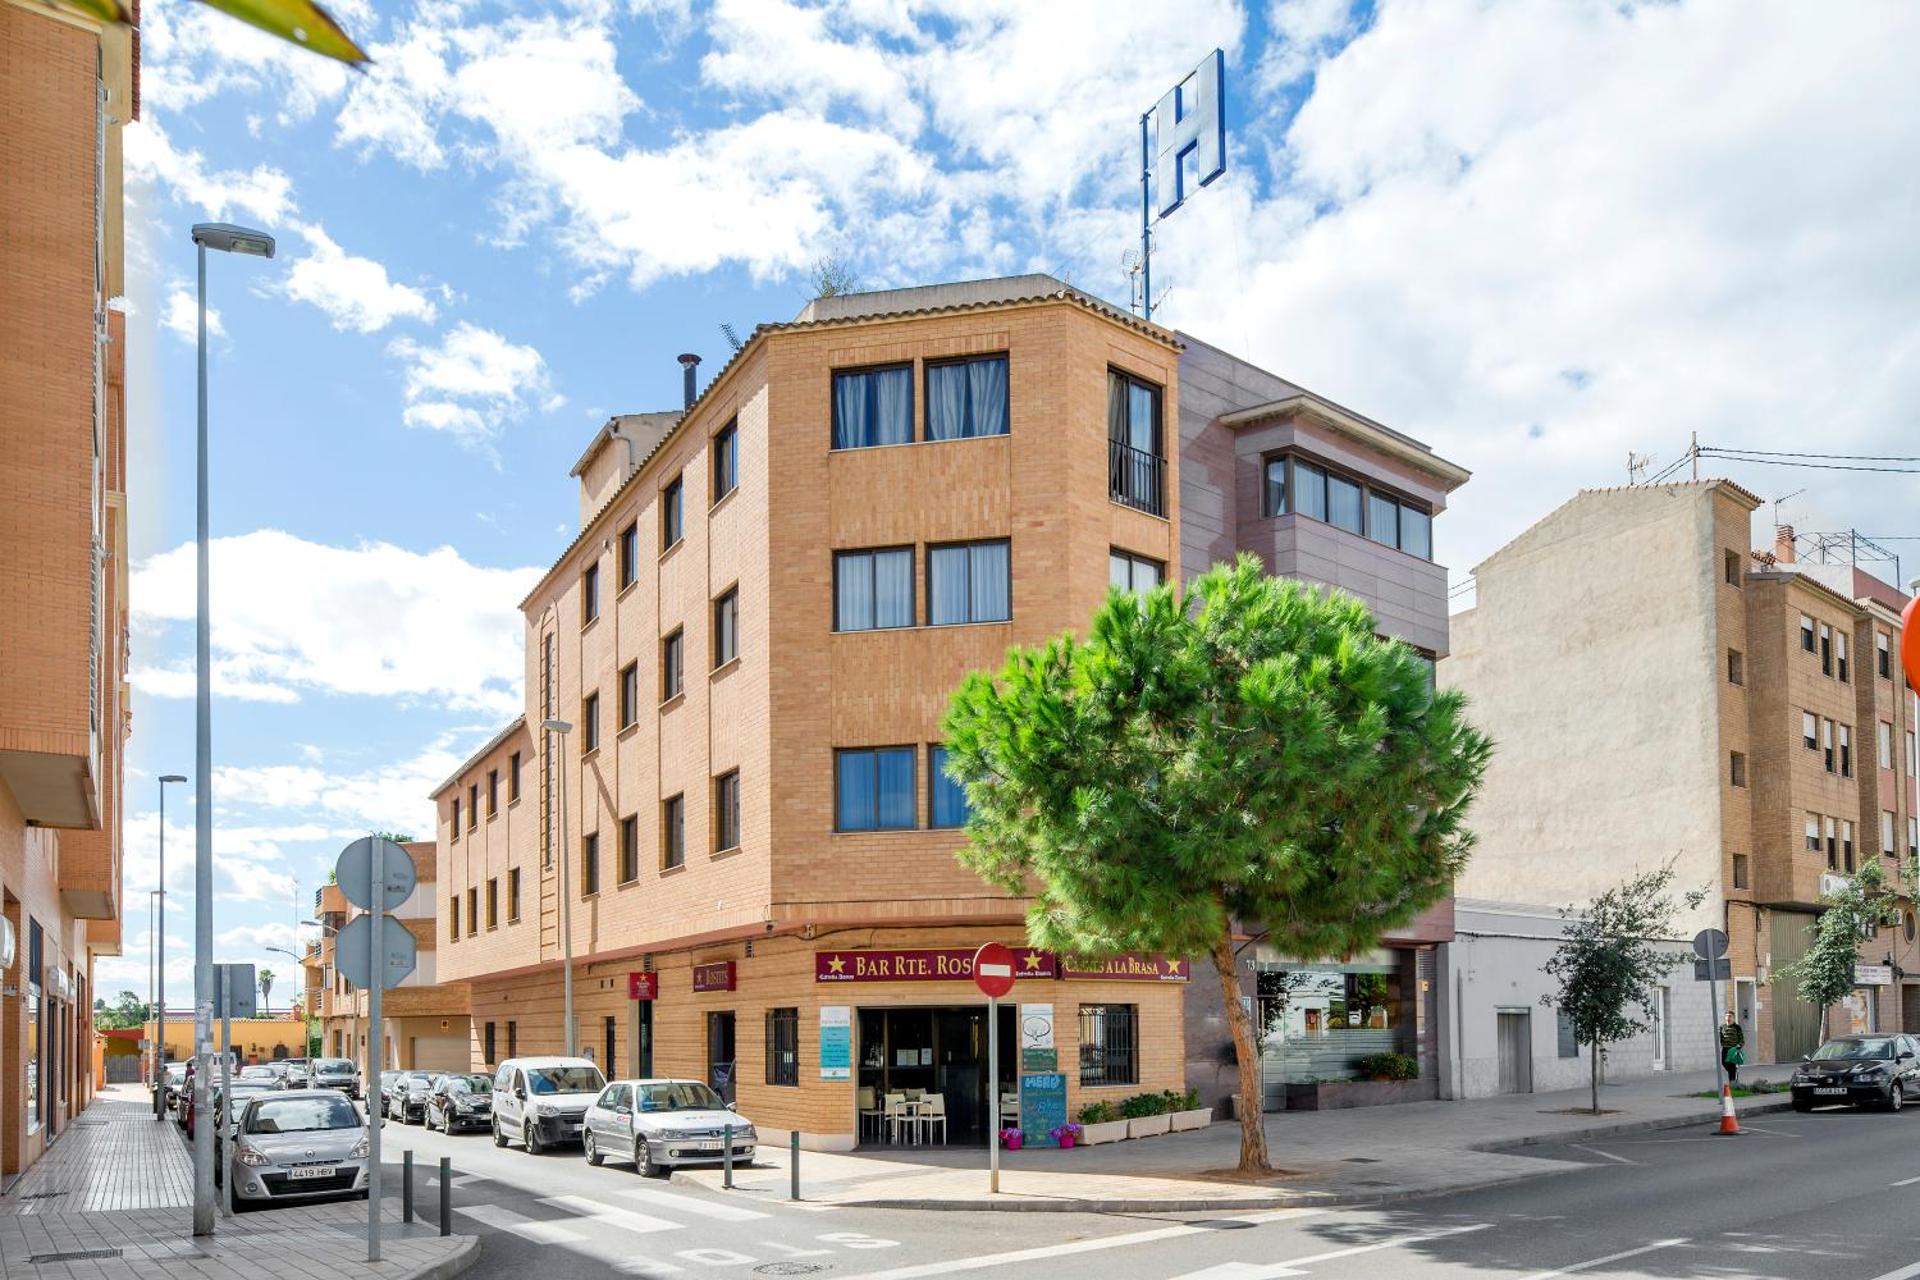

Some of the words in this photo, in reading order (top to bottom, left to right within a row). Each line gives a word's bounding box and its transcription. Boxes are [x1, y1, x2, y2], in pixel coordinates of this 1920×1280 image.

[1156, 48, 1226, 219] H
[856, 956, 889, 977] BAR
[895, 955, 932, 976] RTE.
[937, 955, 972, 975] ROS
[1106, 960, 1113, 974] A
[1115, 960, 1127, 974] LA
[1128, 956, 1159, 975] BRASA
[293, 1169, 314, 1177] 4419
